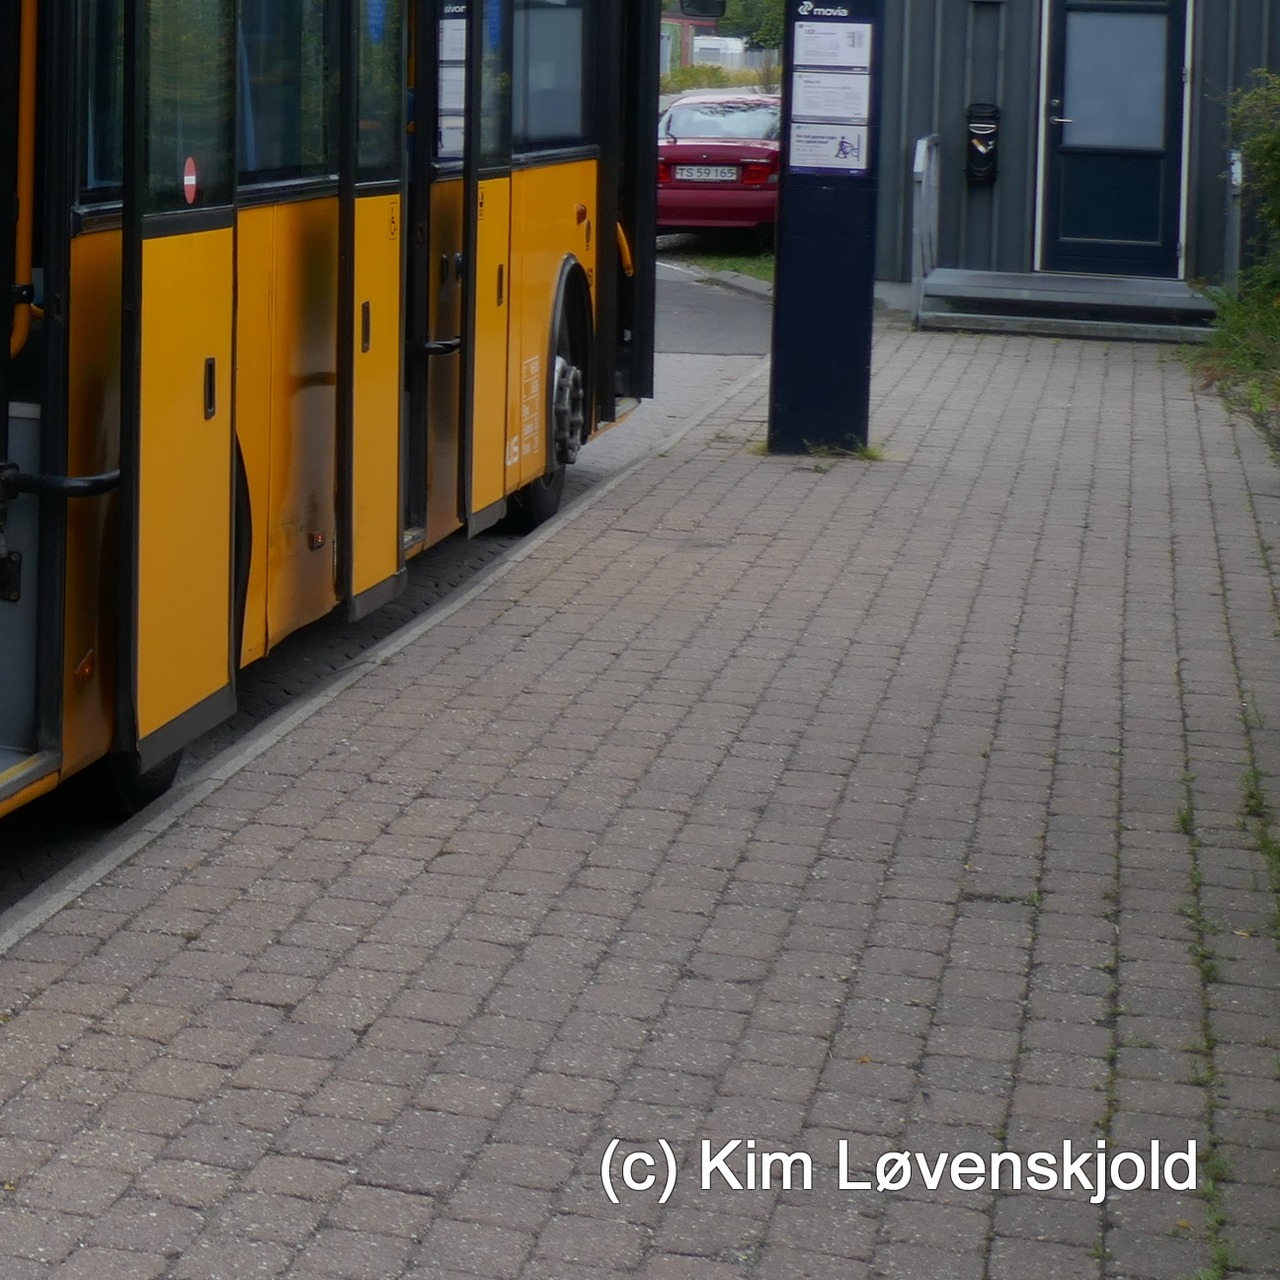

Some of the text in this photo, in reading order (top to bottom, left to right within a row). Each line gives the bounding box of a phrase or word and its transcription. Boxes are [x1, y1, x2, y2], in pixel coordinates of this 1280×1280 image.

[813, 7, 848, 16] movia
[678, 167, 735, 179] TS 59 165
